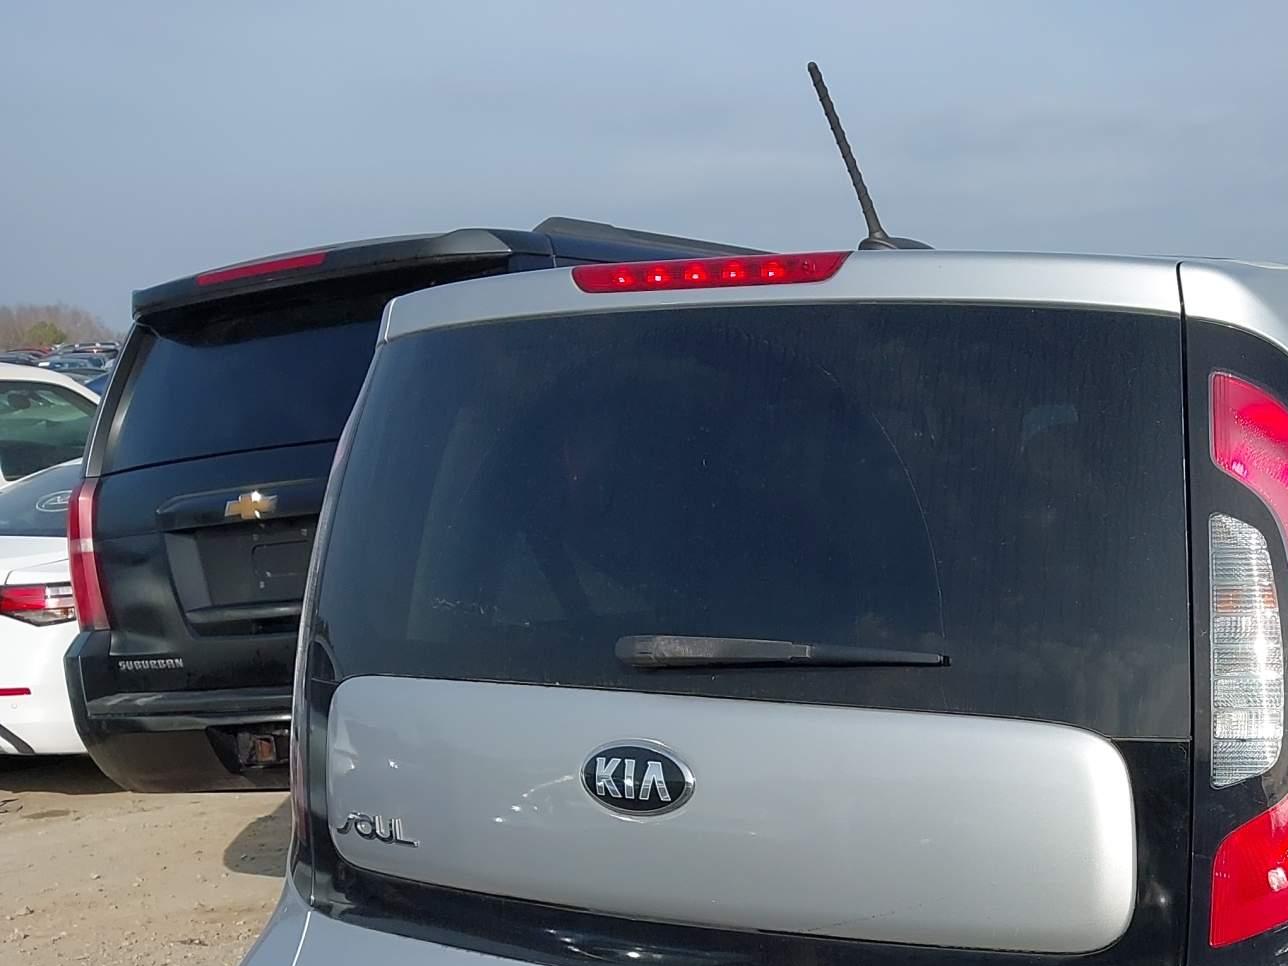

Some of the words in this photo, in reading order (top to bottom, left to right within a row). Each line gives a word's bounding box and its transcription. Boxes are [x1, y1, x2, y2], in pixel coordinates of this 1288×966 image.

[118, 658, 184, 671] SUBURBAN
[596, 756, 672, 802] KIA
[336, 812, 420, 848] SOUL
